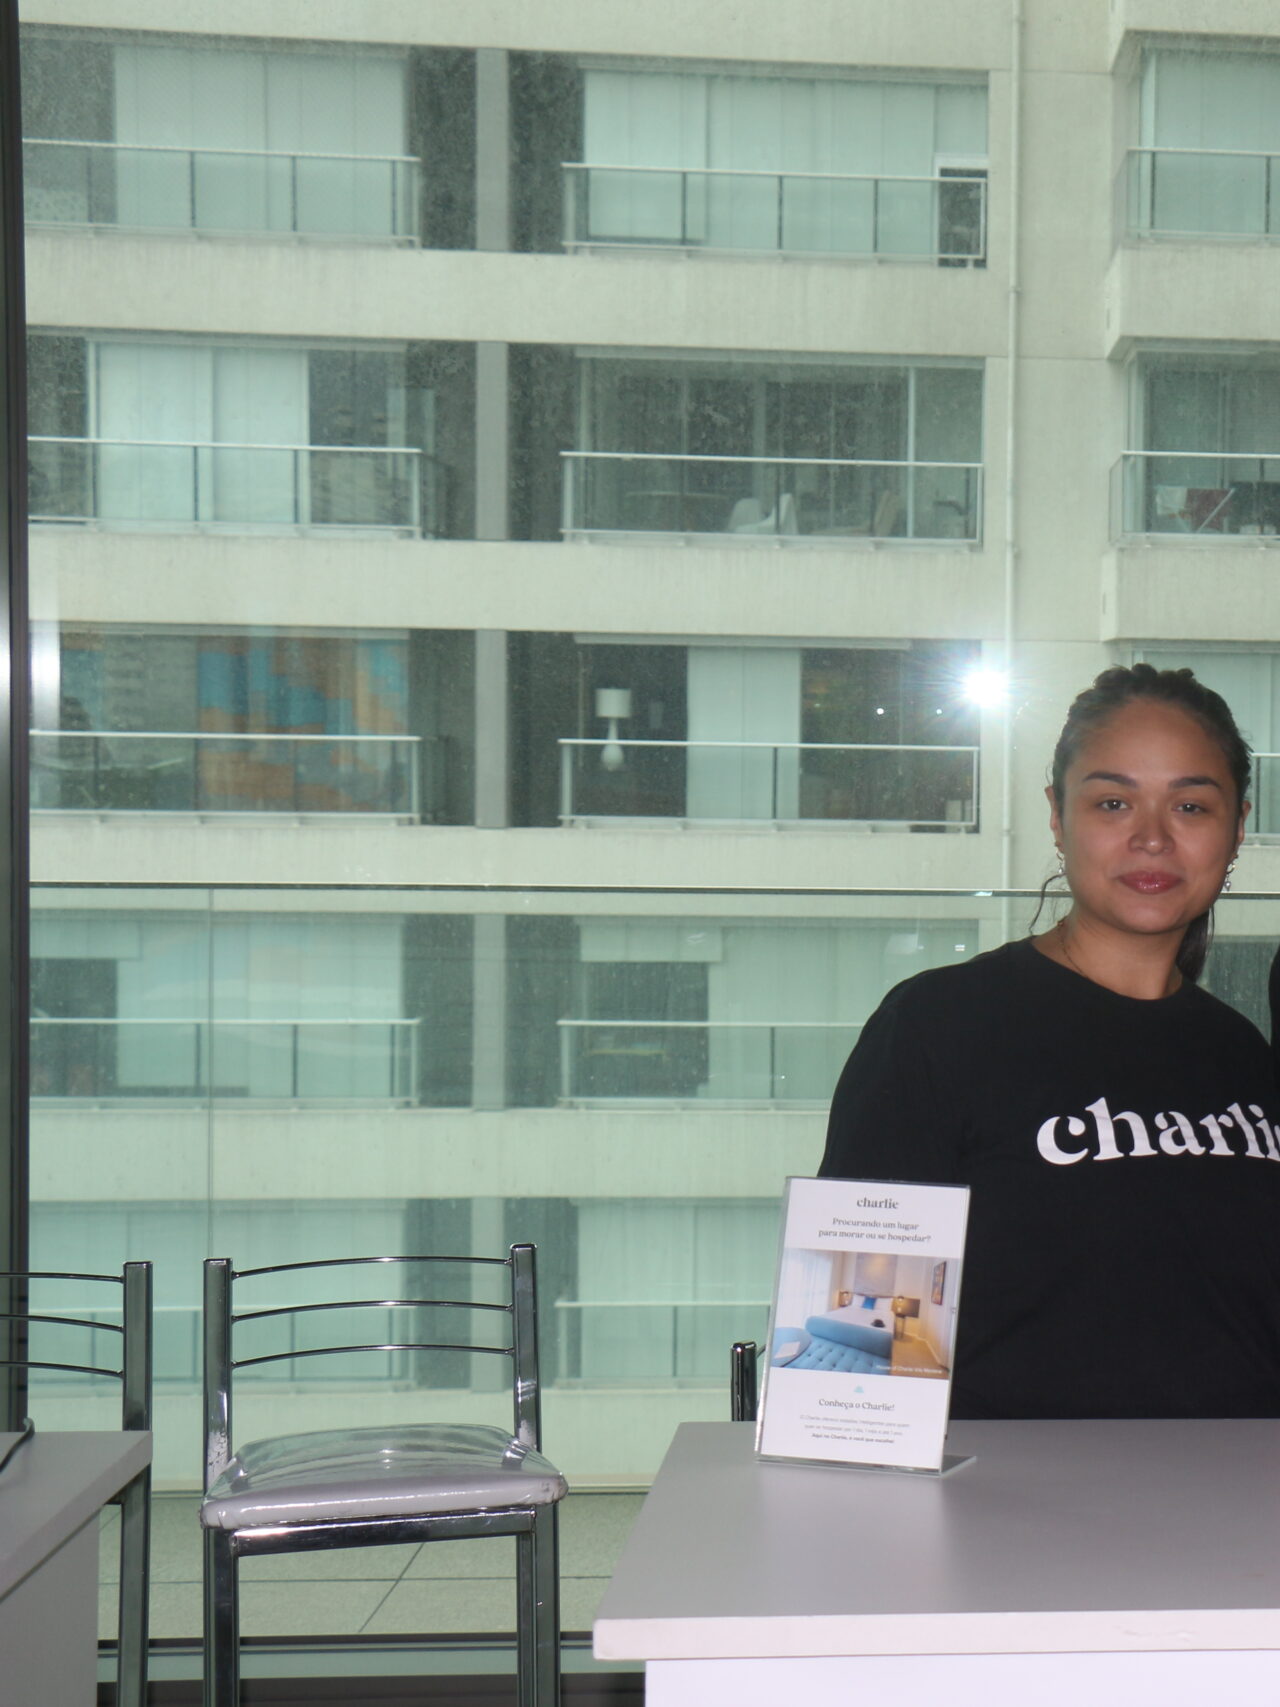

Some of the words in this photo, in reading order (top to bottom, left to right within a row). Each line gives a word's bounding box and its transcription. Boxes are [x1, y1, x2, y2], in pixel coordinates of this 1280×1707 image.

[856, 1197, 899, 1210] charlie
[832, 1217, 881, 1228] Procurando
[882, 1221, 896, 1229] um
[897, 1221, 920, 1231] lugar
[818, 1230, 837, 1238] para
[839, 1230, 865, 1239] morar
[887, 1232, 931, 1243] hospedar?
[818, 1398, 854, 1410] Conheça
[861, 1401, 895, 1412] Charlie!
